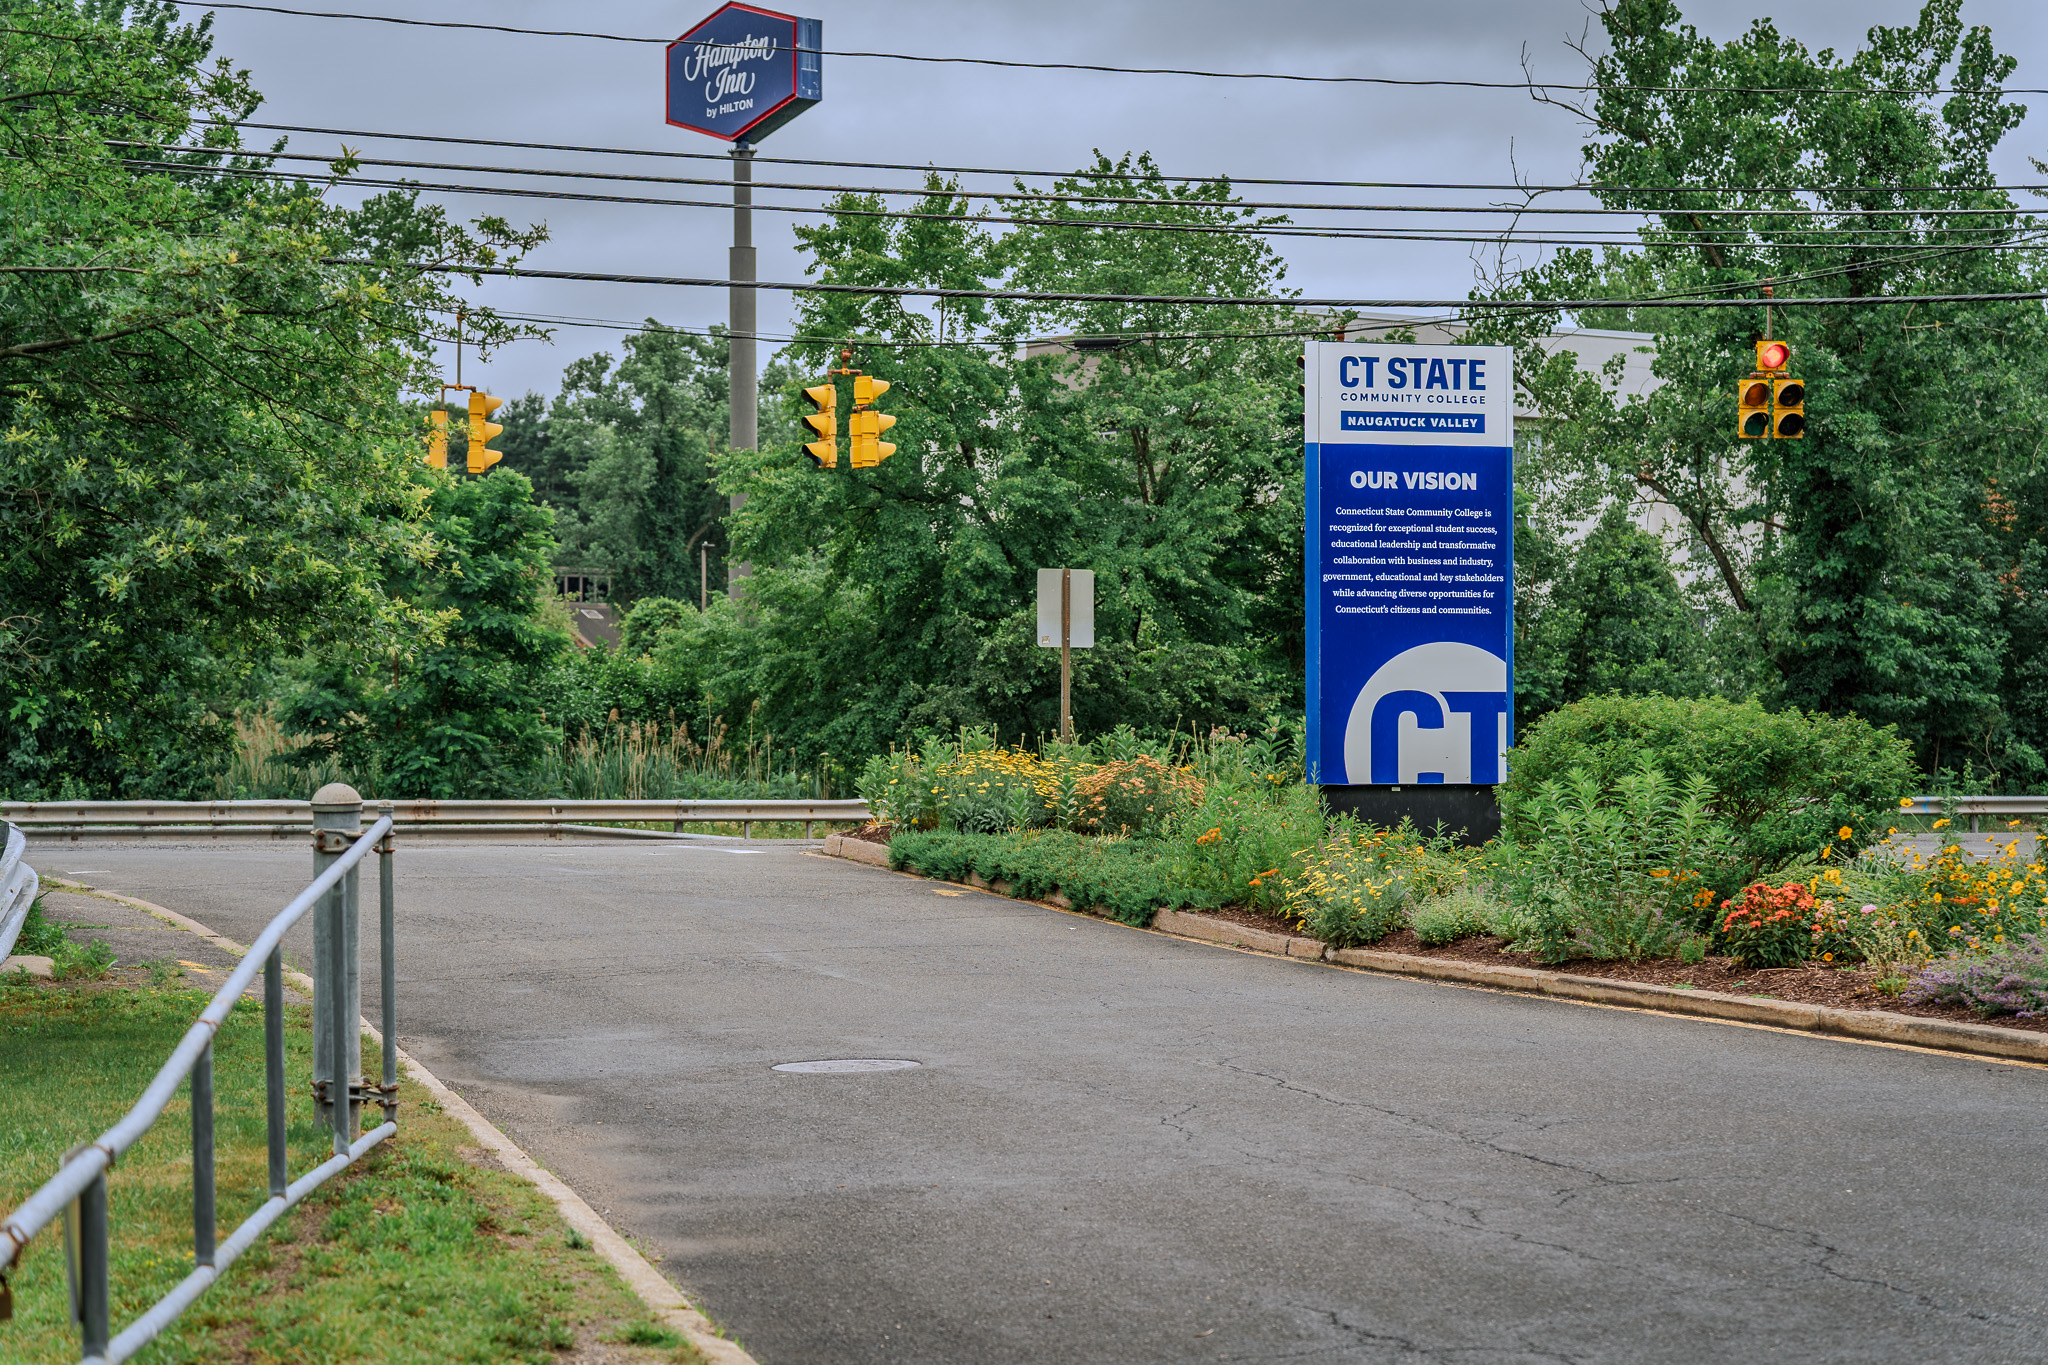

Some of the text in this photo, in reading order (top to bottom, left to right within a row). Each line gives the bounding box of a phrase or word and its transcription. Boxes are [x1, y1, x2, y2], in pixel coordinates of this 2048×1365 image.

[685, 34, 776, 81] Hampton
[705, 66, 755, 103] Inn
[707, 99, 753, 118] by HILTON
[1339, 356, 1486, 390] CT STATE
[1340, 393, 1486, 404] COMMUNITY COLLEGE
[1348, 416, 1478, 428] NAUGATUCK VALLEY
[1350, 471, 1477, 490] OUR VISION
[1336, 507, 1492, 518] Connecticut State Community College is
[1329, 523, 1498, 535] recognized for exceptional student success,
[1331, 539, 1496, 550] educational leadership and transformative
[1333, 556, 1493, 567] collaboration with business and industry,
[1322, 573, 1504, 584] government, educational and key stakeholders
[1333, 588, 1494, 600] while advancing diverse opportunities for
[1335, 605, 1492, 615] Connecticut’s citizens and communities.
